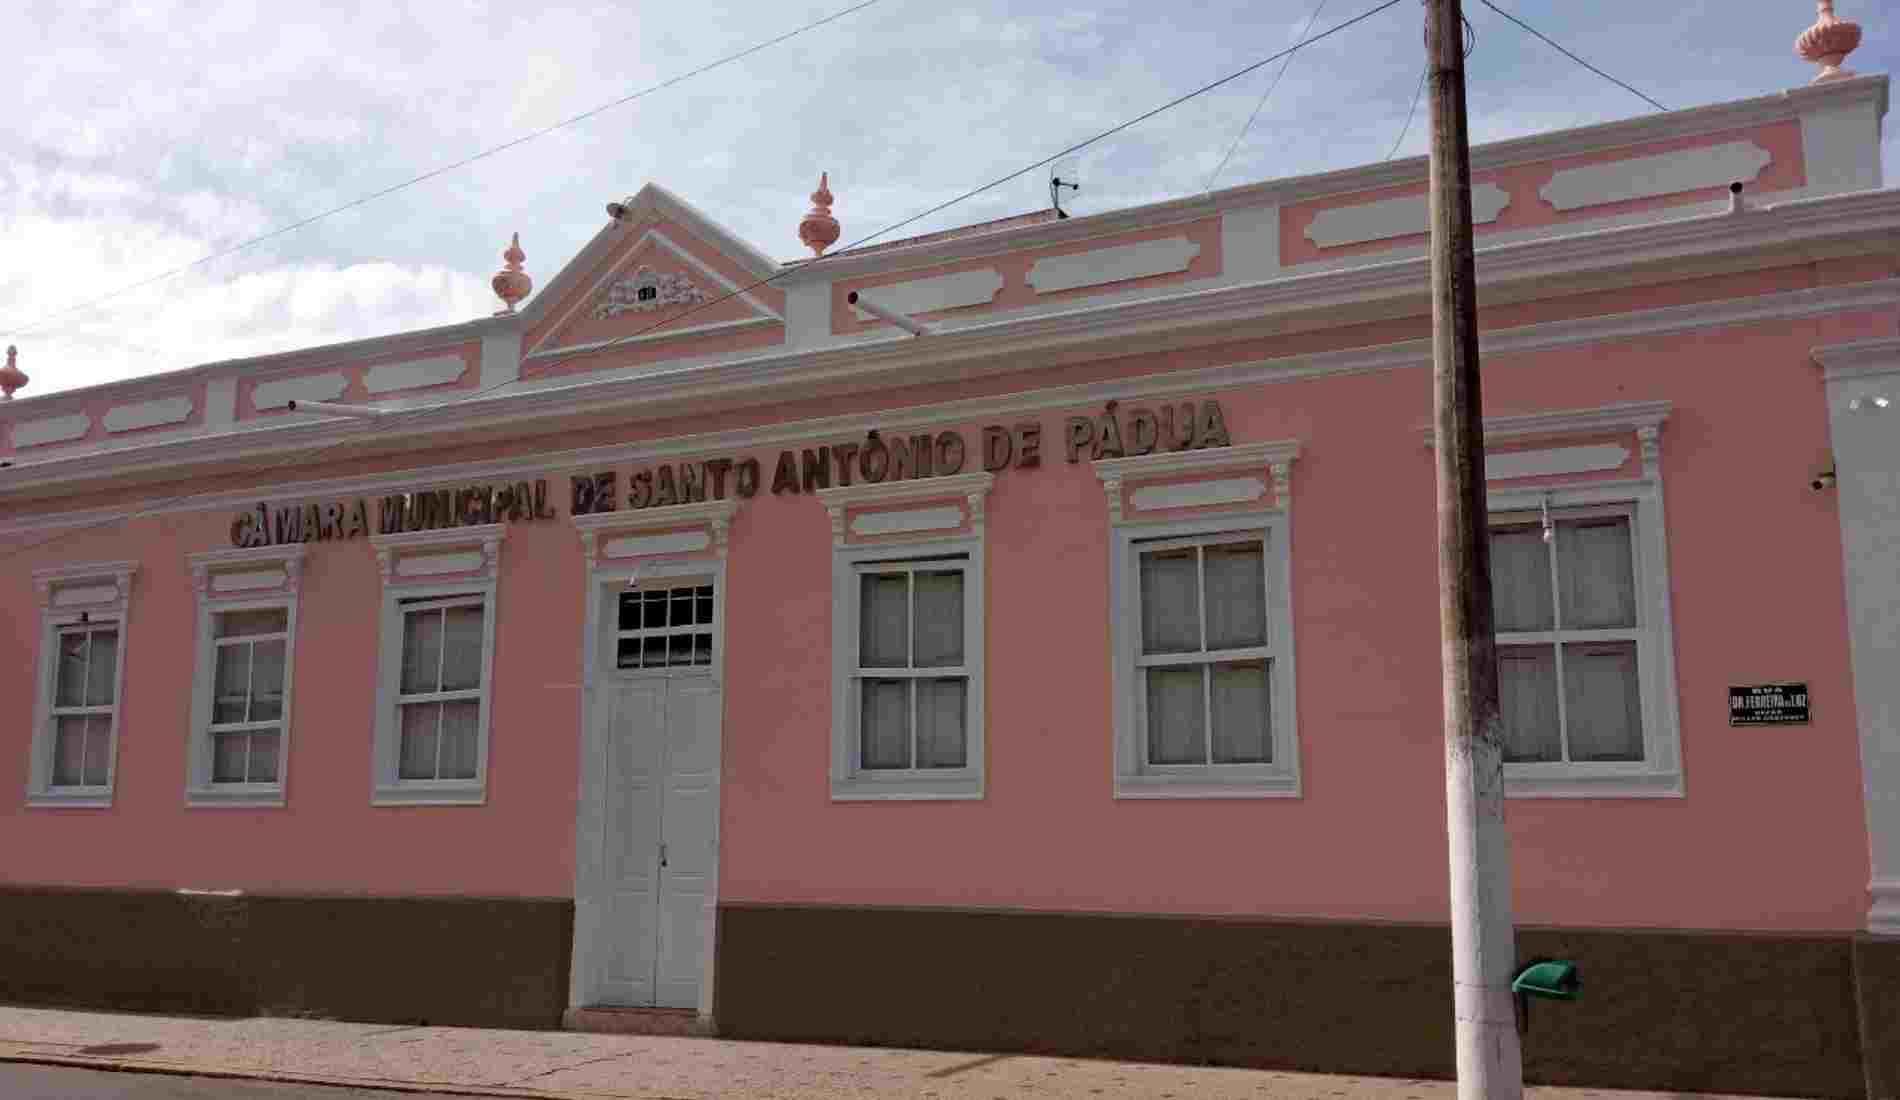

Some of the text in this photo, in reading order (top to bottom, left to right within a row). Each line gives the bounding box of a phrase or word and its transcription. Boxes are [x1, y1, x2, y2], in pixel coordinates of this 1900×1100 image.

[231, 400, 1231, 548] CÂMARA MUNICIPAL DE SANTO ANTÔNIO DE PÁDUA
